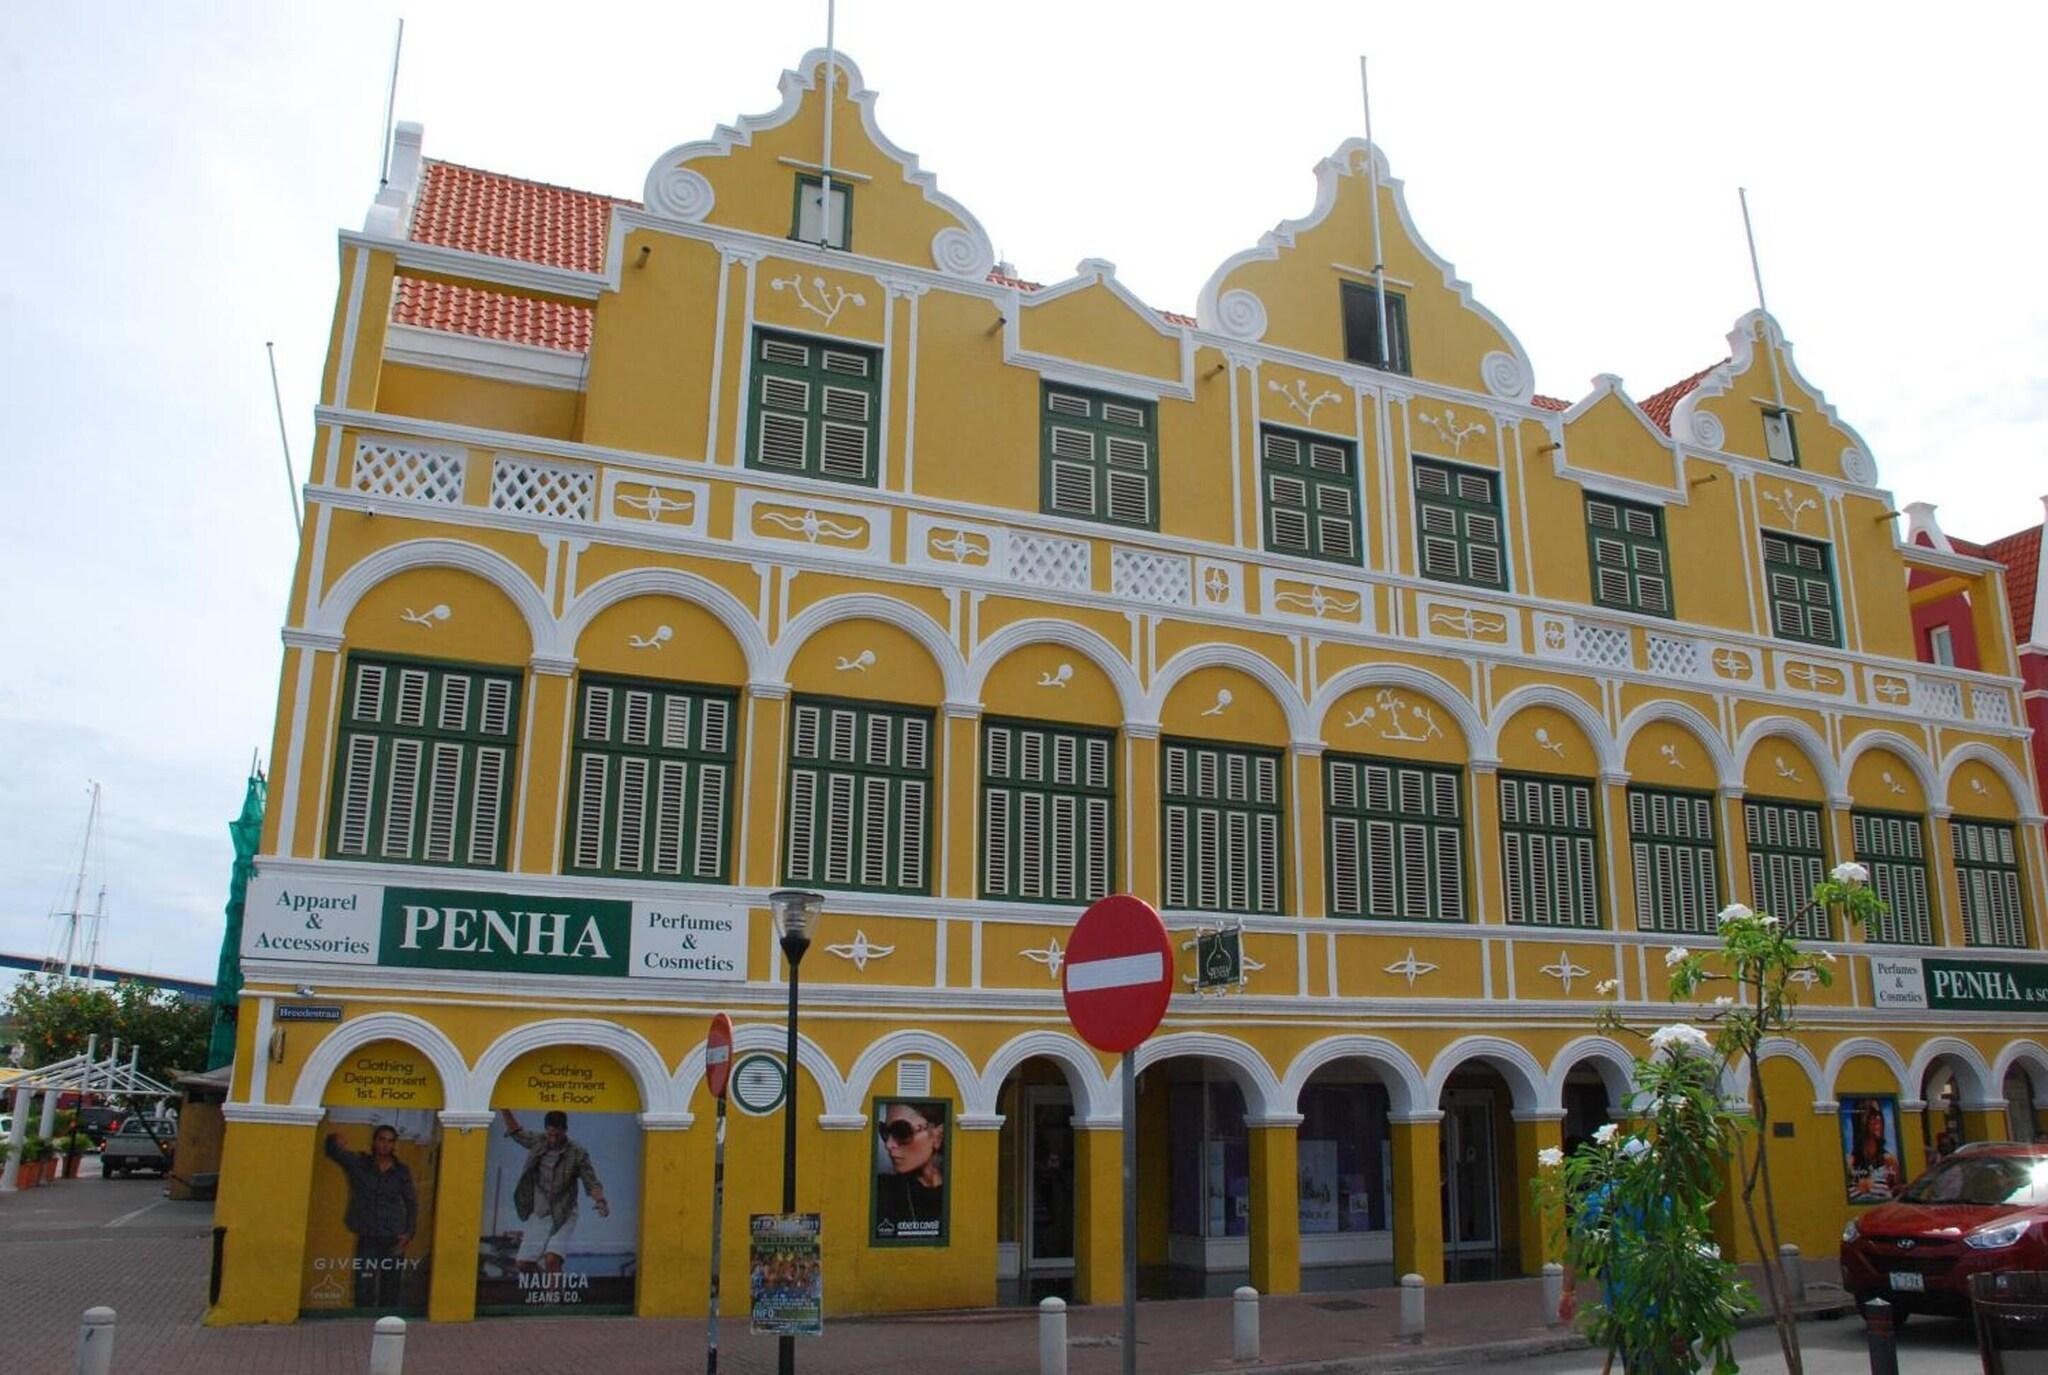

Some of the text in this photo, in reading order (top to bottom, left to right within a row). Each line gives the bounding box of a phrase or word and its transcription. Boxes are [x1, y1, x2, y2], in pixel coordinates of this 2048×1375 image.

[275, 889, 358, 912] Apparel
[305, 912, 324, 930] &
[648, 911, 733, 932] Perfumes
[399, 905, 612, 959] PENHA
[254, 931, 370, 954] Accessories
[681, 933, 698, 950] &
[643, 951, 735, 972] Cosmetics
[1877, 962, 1918, 975] Perfumes
[1895, 976, 1904, 989] &
[1932, 969, 2022, 1000] PENHA
[2025, 987, 2035, 1001] &
[1879, 990, 1922, 1003] Cosmetics
[356, 1059, 414, 1075] Clothing
[540, 1064, 593, 1080] Clothing
[343, 1072, 427, 1088] Department
[527, 1076, 607, 1092] Department
[381, 1087, 416, 1100] Floor
[563, 1092, 595, 1104] Floor
[313, 1257, 421, 1270] GIVENCHY
[518, 1272, 588, 1289] NAUTICA
[525, 1291, 581, 1303] JEANS CO.
